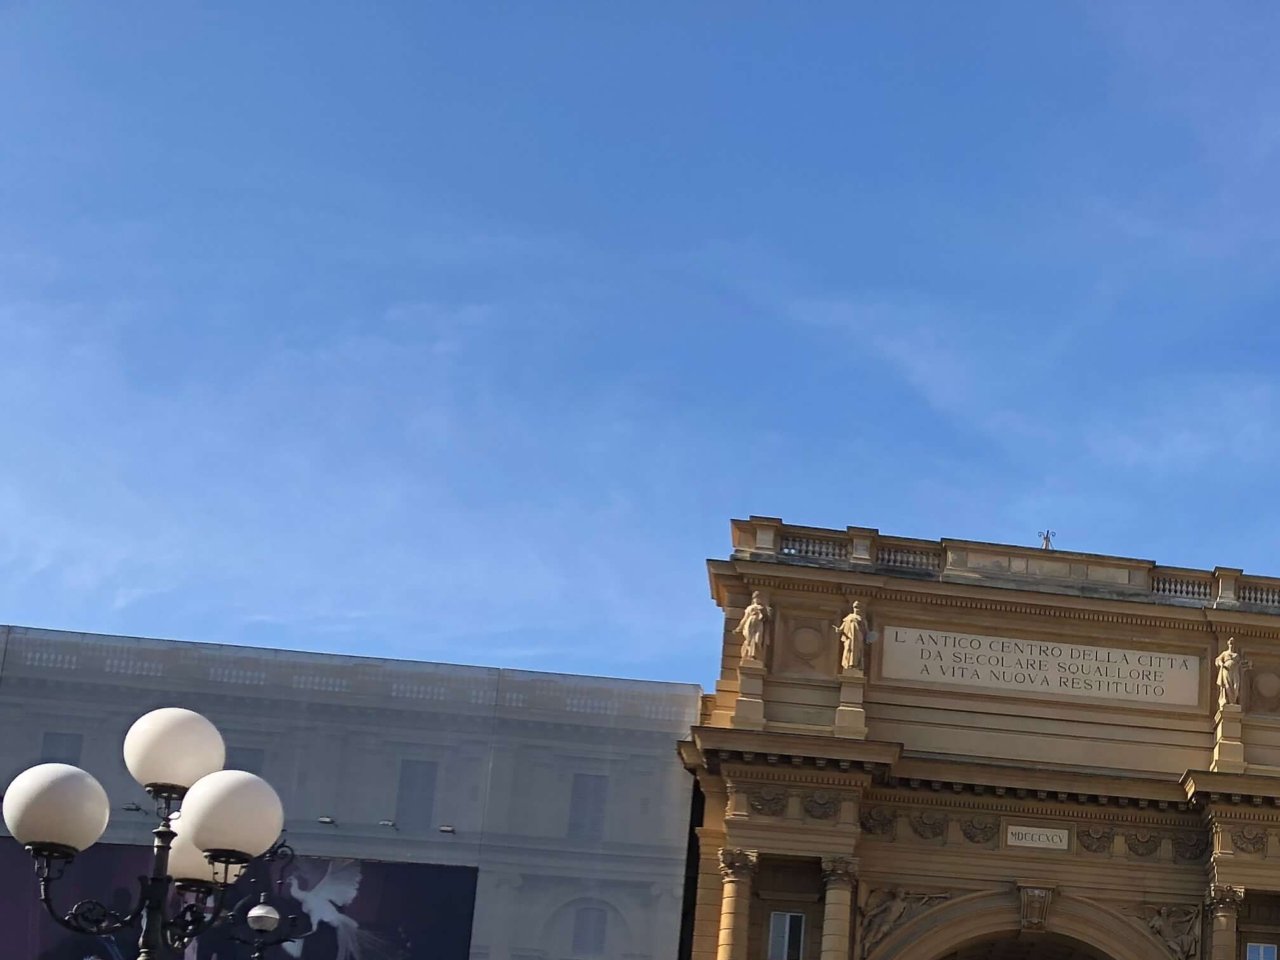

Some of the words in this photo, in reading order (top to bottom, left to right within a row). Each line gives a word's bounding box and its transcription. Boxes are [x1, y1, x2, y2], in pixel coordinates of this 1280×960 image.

[915, 634, 982, 651] ANTICO
[989, 640, 1062, 658] CENTRO
[1070, 647, 1130, 665] DELLA
[920, 648, 943, 662] DA
[952, 651, 1049, 672] SECOLARE
[1057, 662, 1165, 683] SQUALLORE
[920, 664, 930, 676] A
[940, 665, 981, 681] VITA
[989, 671, 1051, 687] NUOVA
[1058, 677, 1166, 697] RESTITUITO
